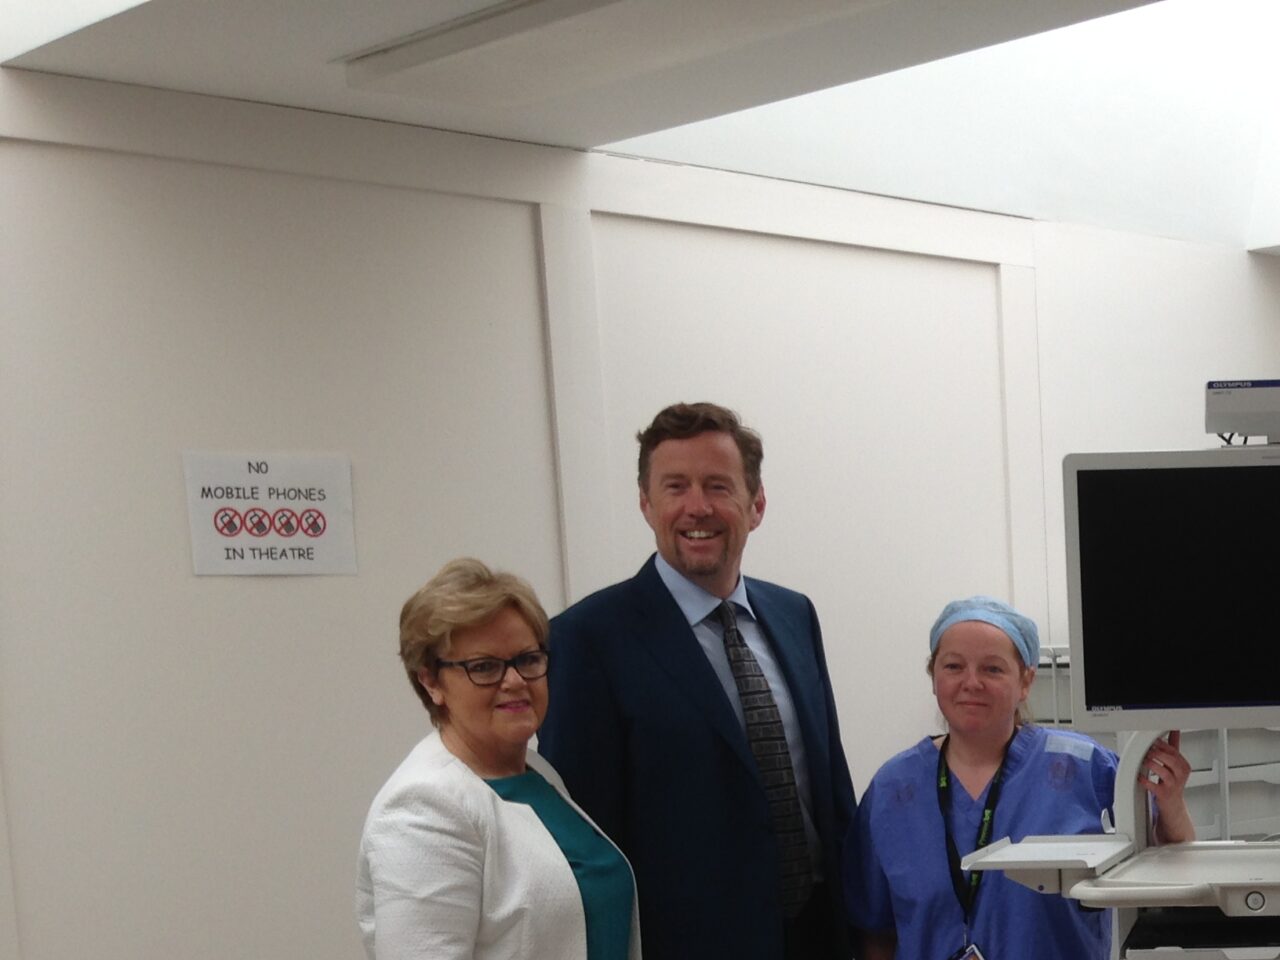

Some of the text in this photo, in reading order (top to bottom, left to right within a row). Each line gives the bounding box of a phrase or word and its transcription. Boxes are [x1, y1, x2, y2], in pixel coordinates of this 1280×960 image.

[248, 461, 269, 474] NO
[200, 486, 327, 501] MOBILE PHONES
[224, 547, 315, 561] IN THEATRE
